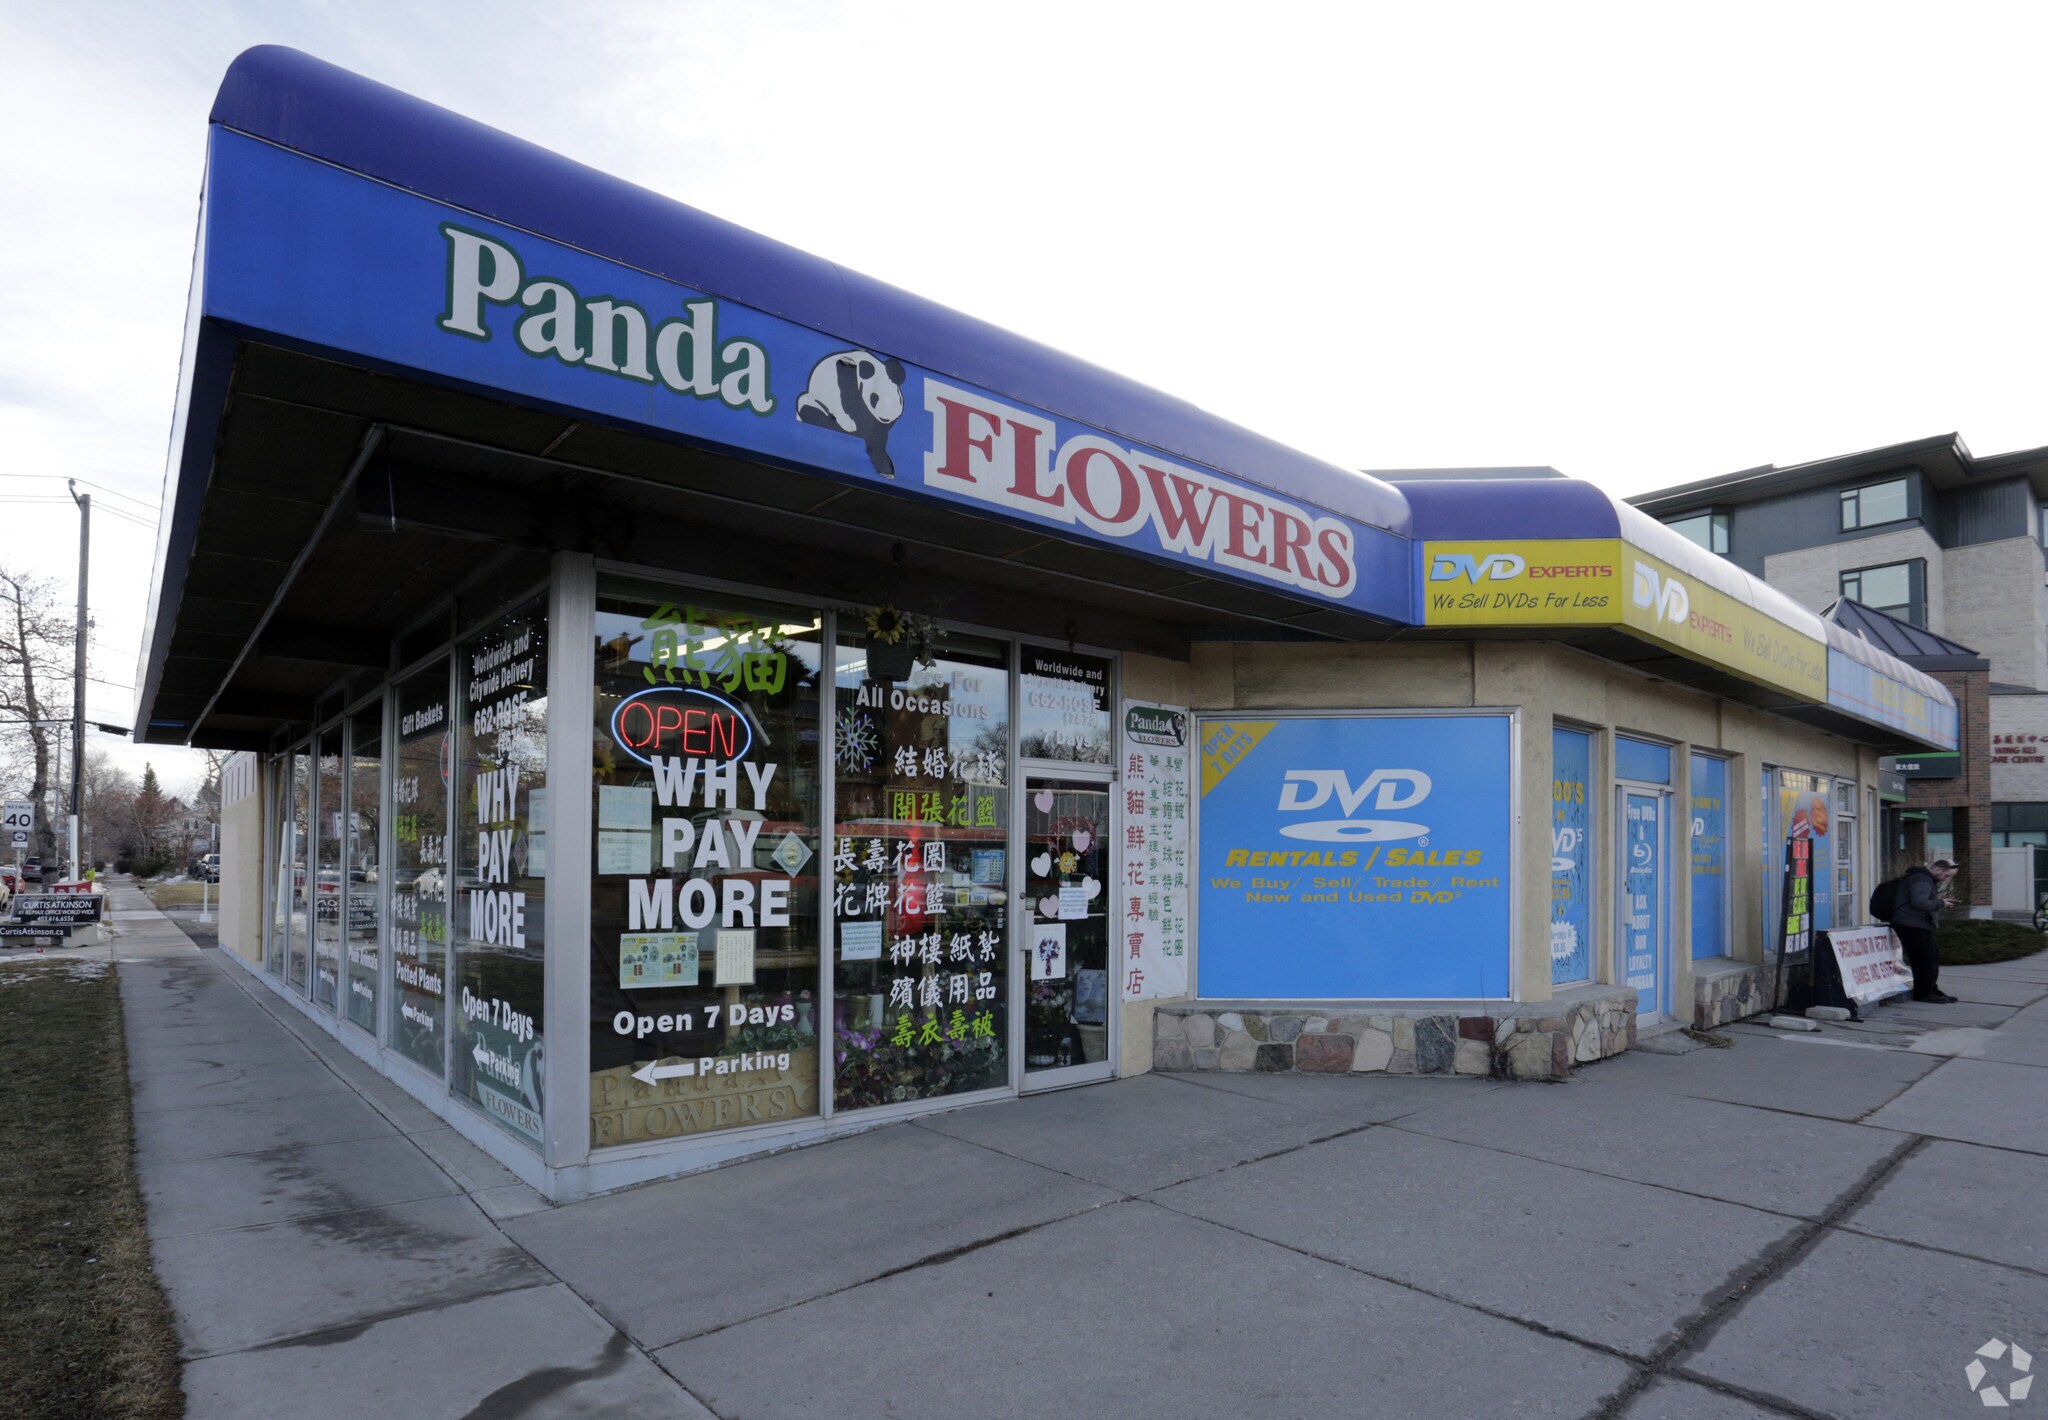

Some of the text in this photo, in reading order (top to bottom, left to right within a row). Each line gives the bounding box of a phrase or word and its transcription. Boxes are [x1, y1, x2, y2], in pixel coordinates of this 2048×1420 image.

[440, 224, 775, 415] Panda
[934, 395, 1352, 590] FLOWERS
[1429, 553, 1613, 586] DVD EXPERTS
[1433, 592, 1609, 610] We Sell DVDs For Less
[1632, 559, 1732, 644] DVD EXPERTS
[473, 627, 530, 676] Worldwide and
[641, 602, 788, 696] 熊貓
[469, 658, 534, 703] Citywide Delivery
[1035, 659, 1103, 680] Worldwide and
[402, 702, 444, 736] Gift Baskets
[473, 690, 528, 737] 662-ROSE
[856, 685, 991, 721] All Occasions
[620, 701, 735, 758] OPEN
[1130, 712, 1166, 732] Panda
[1138, 733, 1177, 745] FLOWERS
[1203, 723, 1236, 758] OPEN
[1210, 731, 1254, 774] 7 DAYS
[1990, 755, 2010, 763] ARE
[476, 764, 520, 825] WHY
[650, 754, 778, 810] WHY
[1277, 768, 1433, 819] DVD
[5, 812, 32, 828] 40
[1627, 804, 1640, 820] Free
[478, 828, 513, 884] PAY
[662, 817, 763, 869] PAY
[1224, 849, 1359, 867] RENTALS
[1384, 848, 1483, 867] SALES
[1210, 877, 1242, 889] We
[1451, 876, 1500, 888] Rent
[1246, 891, 1291, 903] New
[1301, 891, 1339, 903] and
[1348, 891, 1402, 903] Used
[22, 900, 92, 910] CURTIS ATKINSON
[470, 889, 526, 949] MORE
[628, 877, 791, 930] MORE
[1635, 894, 1648, 910] ASK
[0, 927, 64, 936] CurtisAtkinson.ca
[1632, 914, 1651, 930] ABOUT
[396, 960, 442, 995] Potted Plants
[1629, 954, 1652, 972] LOYALTY
[412, 1006, 434, 1032] Parking
[462, 985, 534, 1043] Open 7 Days
[613, 1003, 795, 1039] Open 7 Days
[488, 1052, 520, 1086] Parking
[699, 1051, 791, 1077] Parking
[485, 1090, 540, 1135] FLOWERS
[591, 1089, 790, 1145] FLOWERS
